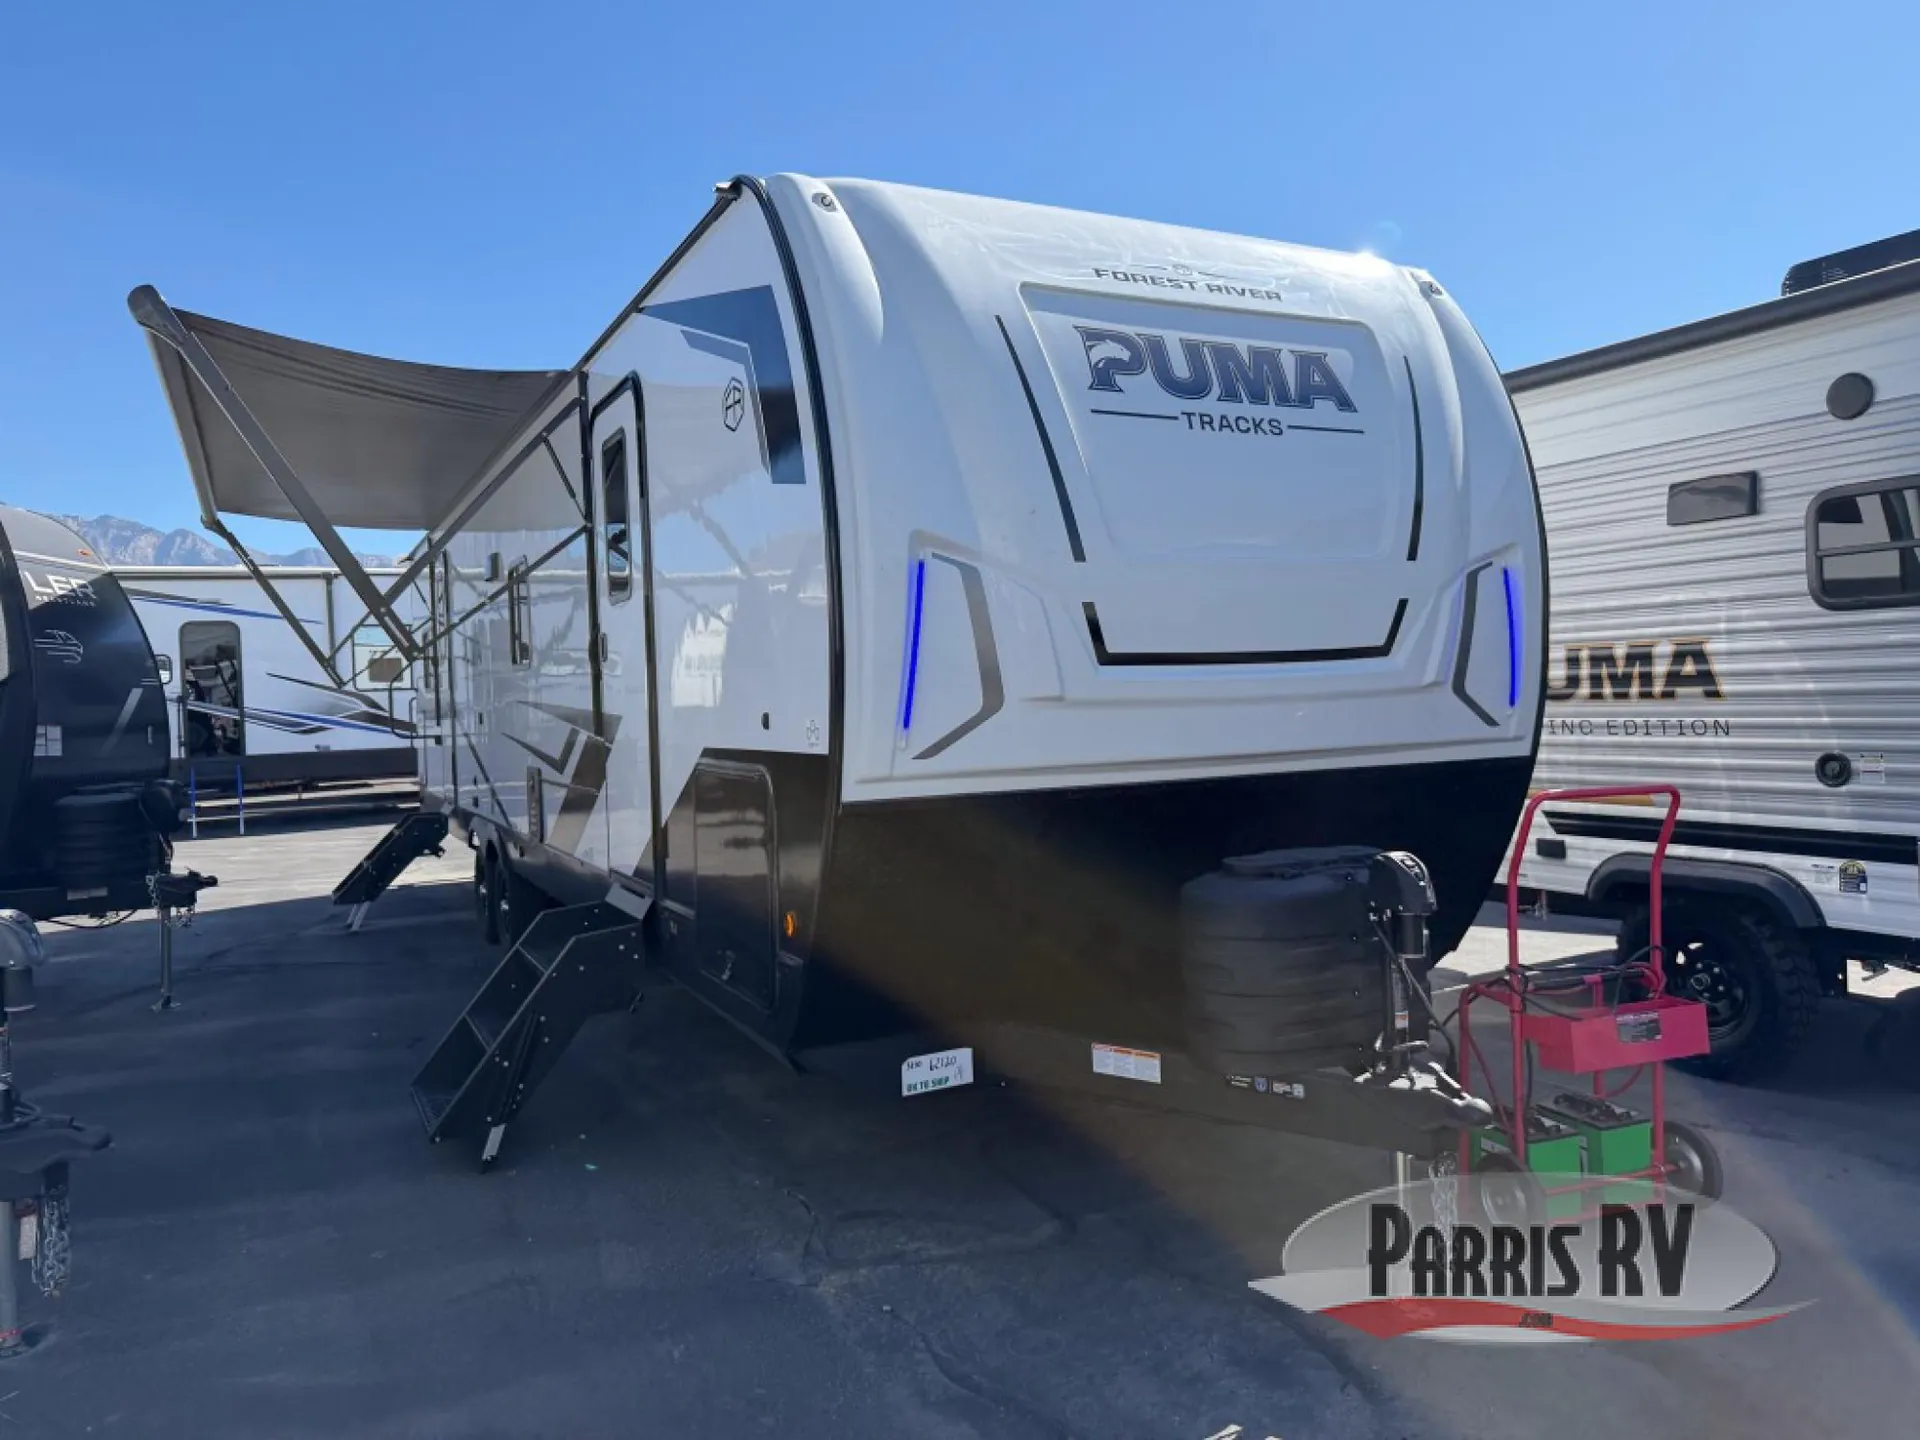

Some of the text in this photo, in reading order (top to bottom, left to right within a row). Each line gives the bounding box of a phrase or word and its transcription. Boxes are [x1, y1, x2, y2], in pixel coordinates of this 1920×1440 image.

[1092, 267, 1283, 301] FOREST RIVER
[1073, 325, 1359, 413] PUMA
[1181, 411, 1284, 436] TRACKS
[1606, 719, 1730, 737] EDITION
